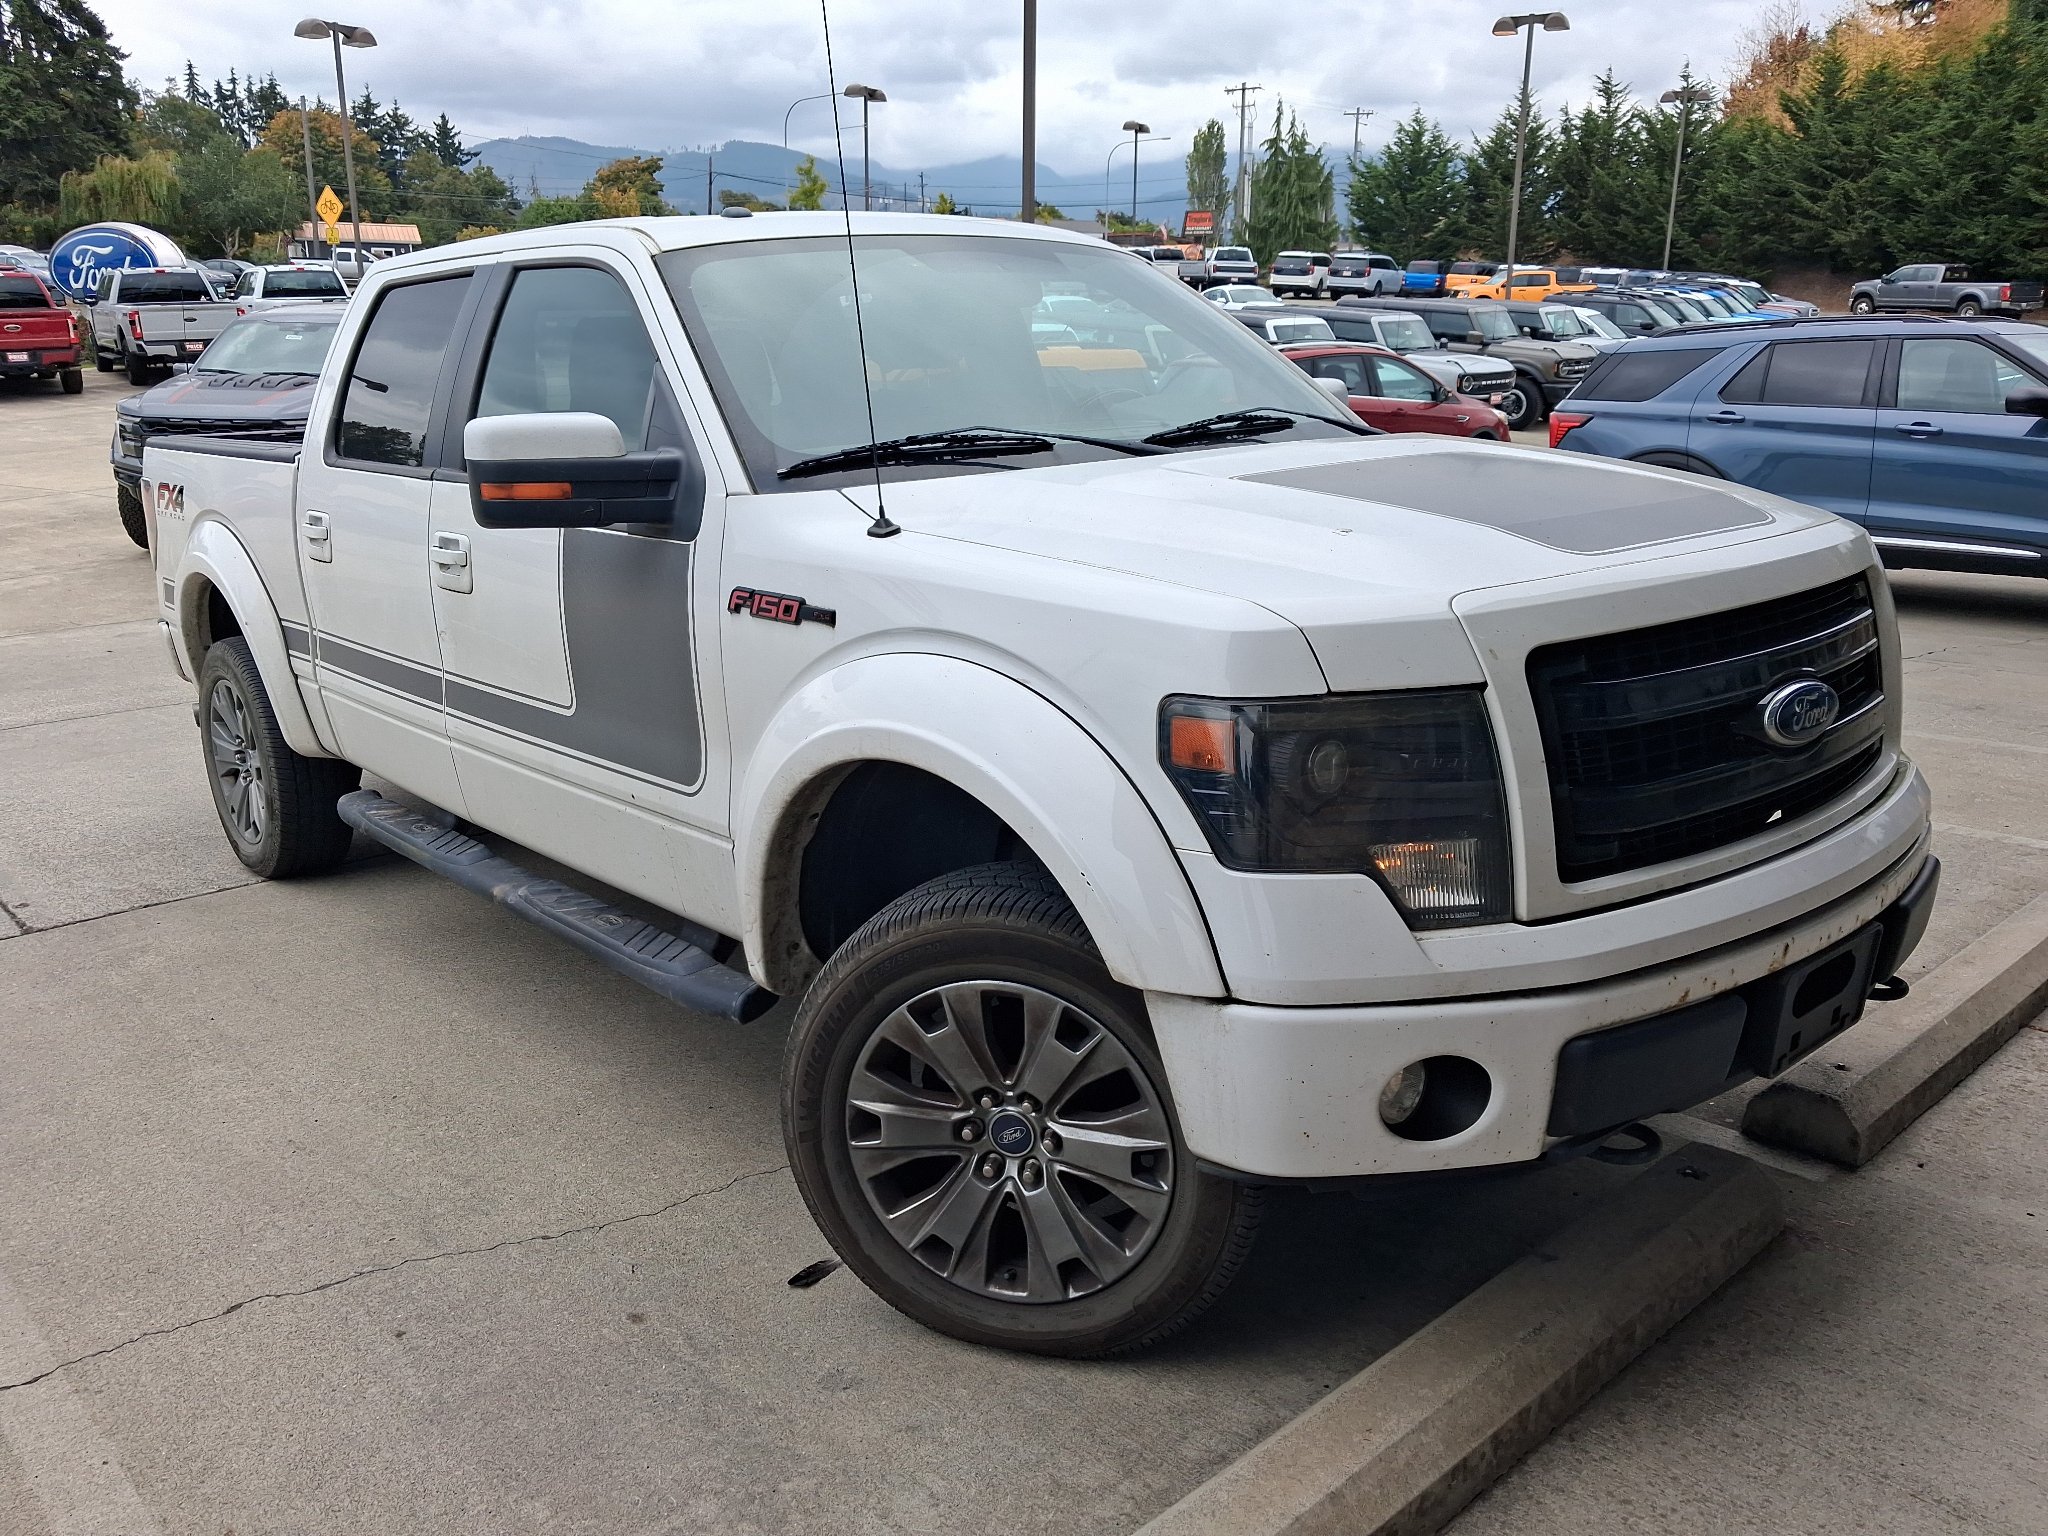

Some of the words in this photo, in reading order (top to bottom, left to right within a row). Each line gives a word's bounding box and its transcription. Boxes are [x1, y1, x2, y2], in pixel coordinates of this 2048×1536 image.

[157, 482, 185, 513] FX4
[729, 588, 802, 623] F-150
[1792, 692, 1829, 732] Ford
[1002, 1129, 1021, 1142] Ford
